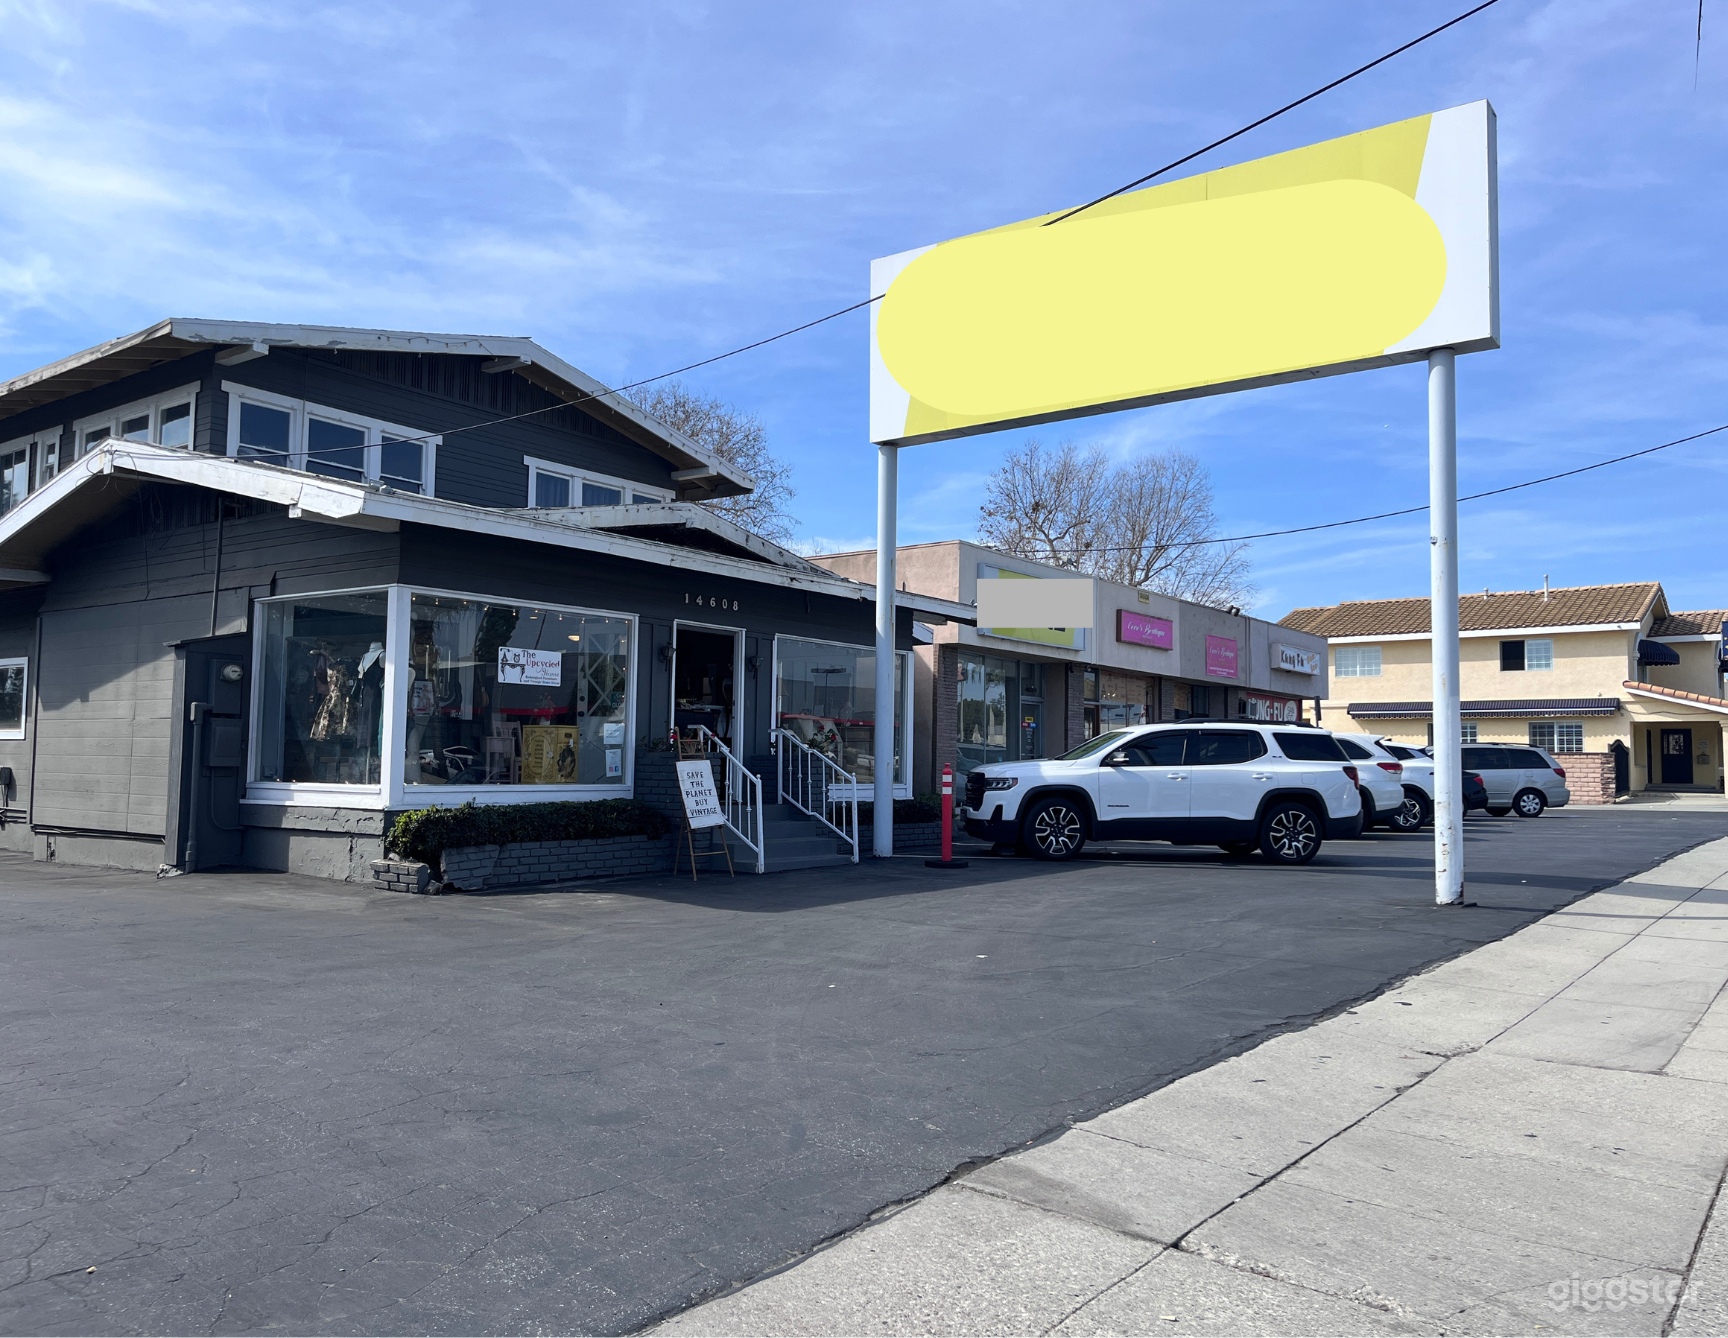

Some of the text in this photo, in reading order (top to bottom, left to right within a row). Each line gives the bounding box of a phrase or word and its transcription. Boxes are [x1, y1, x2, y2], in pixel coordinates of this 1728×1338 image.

[685, 593, 738, 611] 14608
[1144, 623, 1165, 637] Boutique
[522, 650, 536, 659] The
[1281, 649, 1304, 669] Kung Fu
[526, 658, 560, 668] Upcycled
[686, 771, 704, 779] SAVE
[690, 780, 705, 788] THE
[685, 788, 713, 798] PLANET
[694, 798, 709, 807] BUY
[689, 807, 717, 817] VINTAGE
